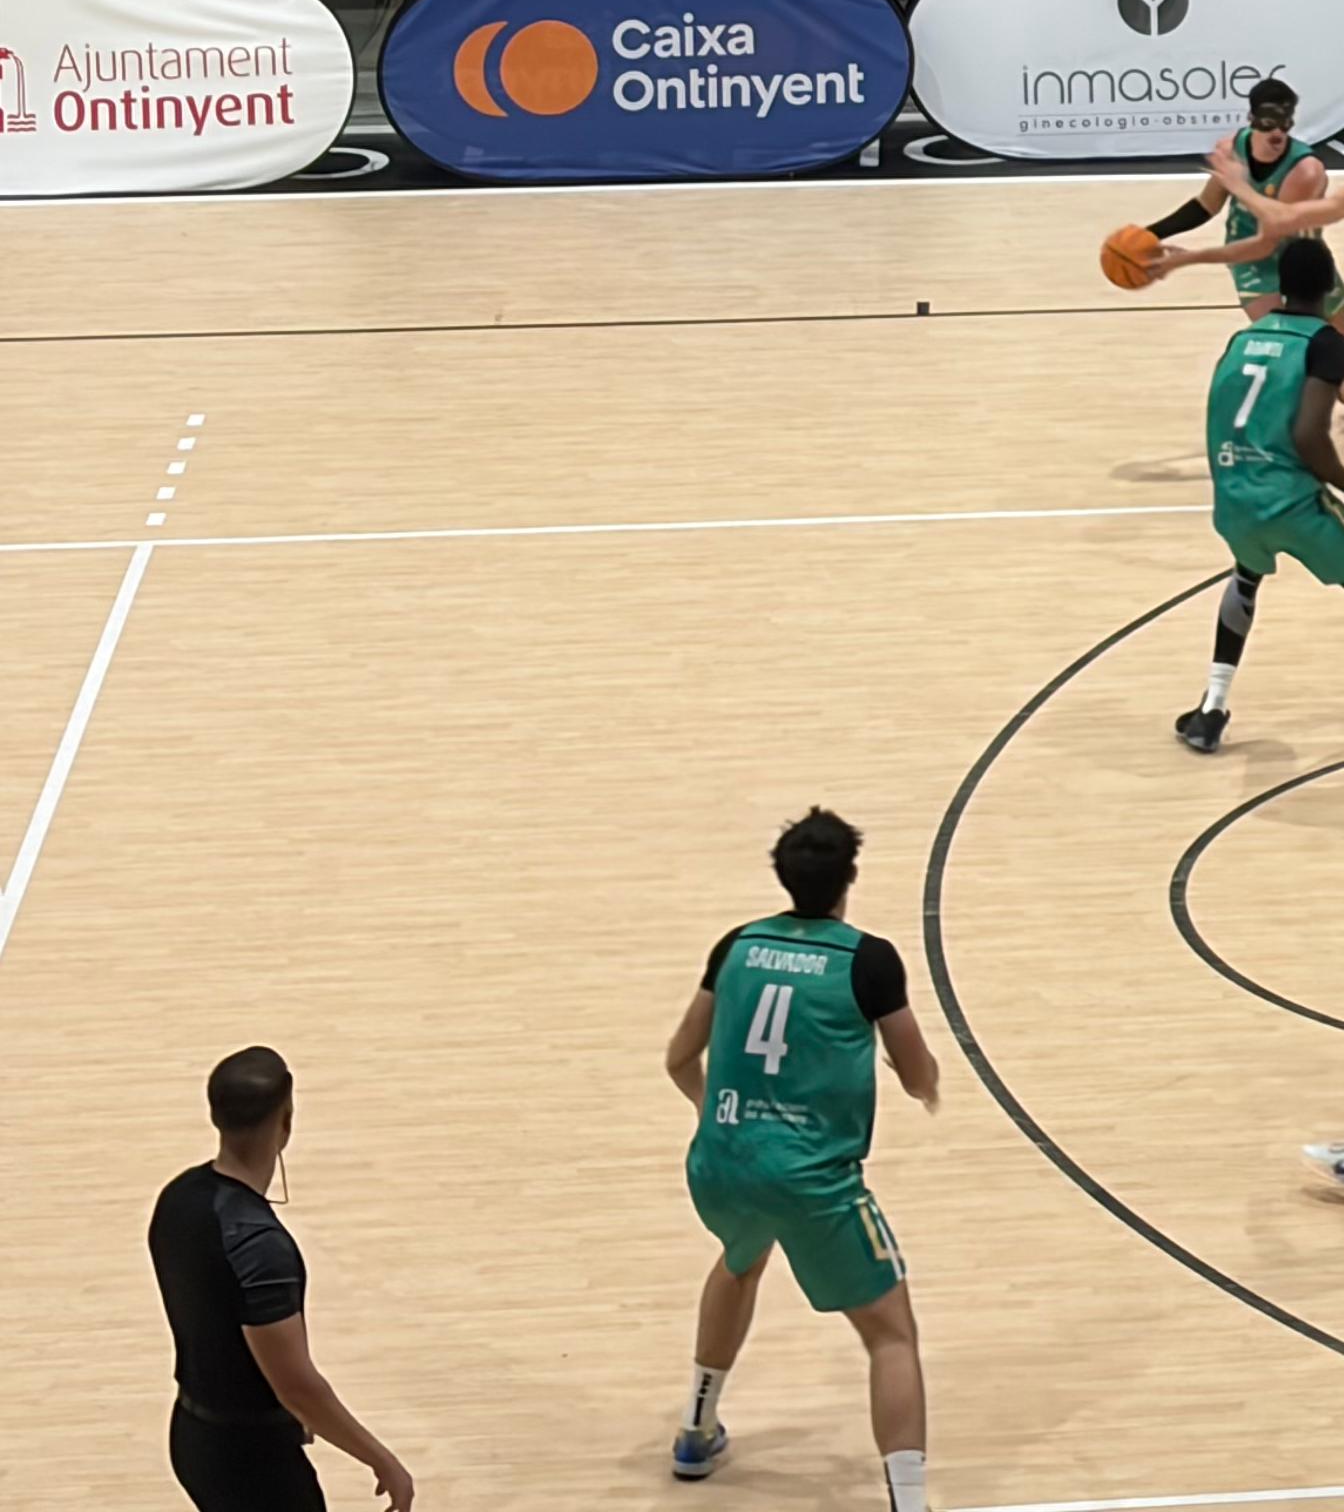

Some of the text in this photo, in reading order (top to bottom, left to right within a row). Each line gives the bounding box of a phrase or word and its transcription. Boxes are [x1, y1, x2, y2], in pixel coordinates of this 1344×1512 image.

[611, 12, 755, 60] Caixa
[53, 38, 294, 92] Ajuntament
[612, 63, 865, 118] Ontinyent
[53, 84, 295, 136] Ontinyent
[1233, 363, 1268, 429] 7
[744, 983, 795, 1076] 4
